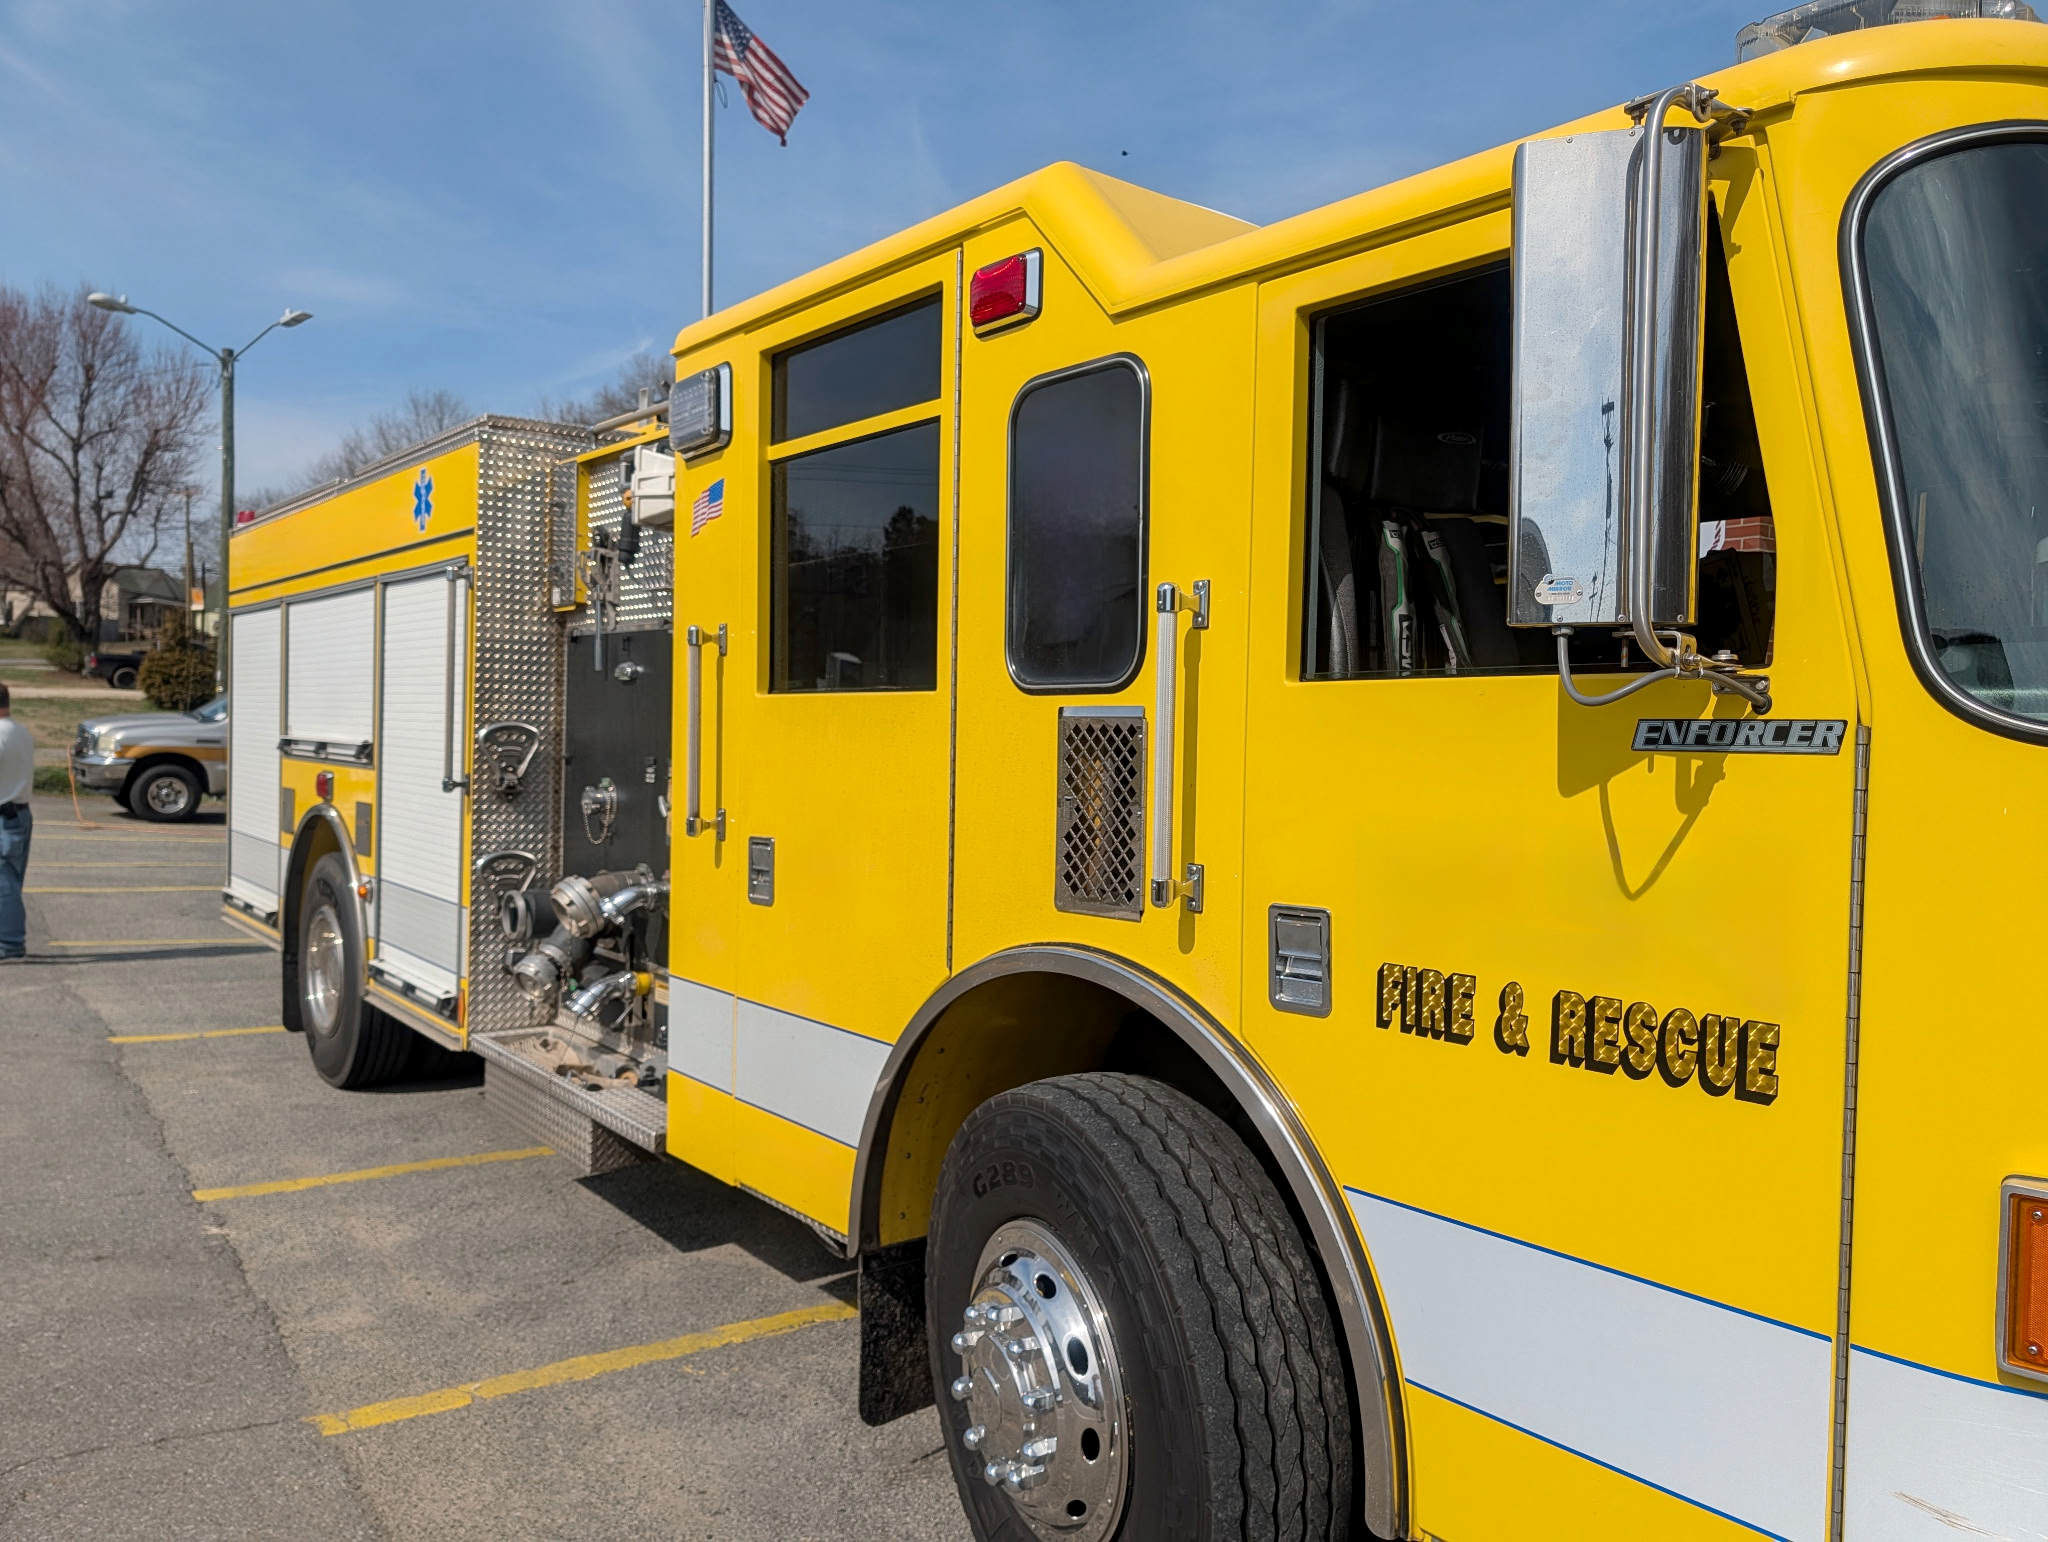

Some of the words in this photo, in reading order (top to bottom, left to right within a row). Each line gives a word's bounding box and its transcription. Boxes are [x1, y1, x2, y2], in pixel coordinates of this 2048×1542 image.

[1634, 720, 1845, 749] ENFORCER
[1376, 963, 1476, 1046] FIRE
[1493, 981, 1530, 1057] &
[1549, 990, 1780, 1106] RESCUE
[972, 1159, 1035, 1198] G289
